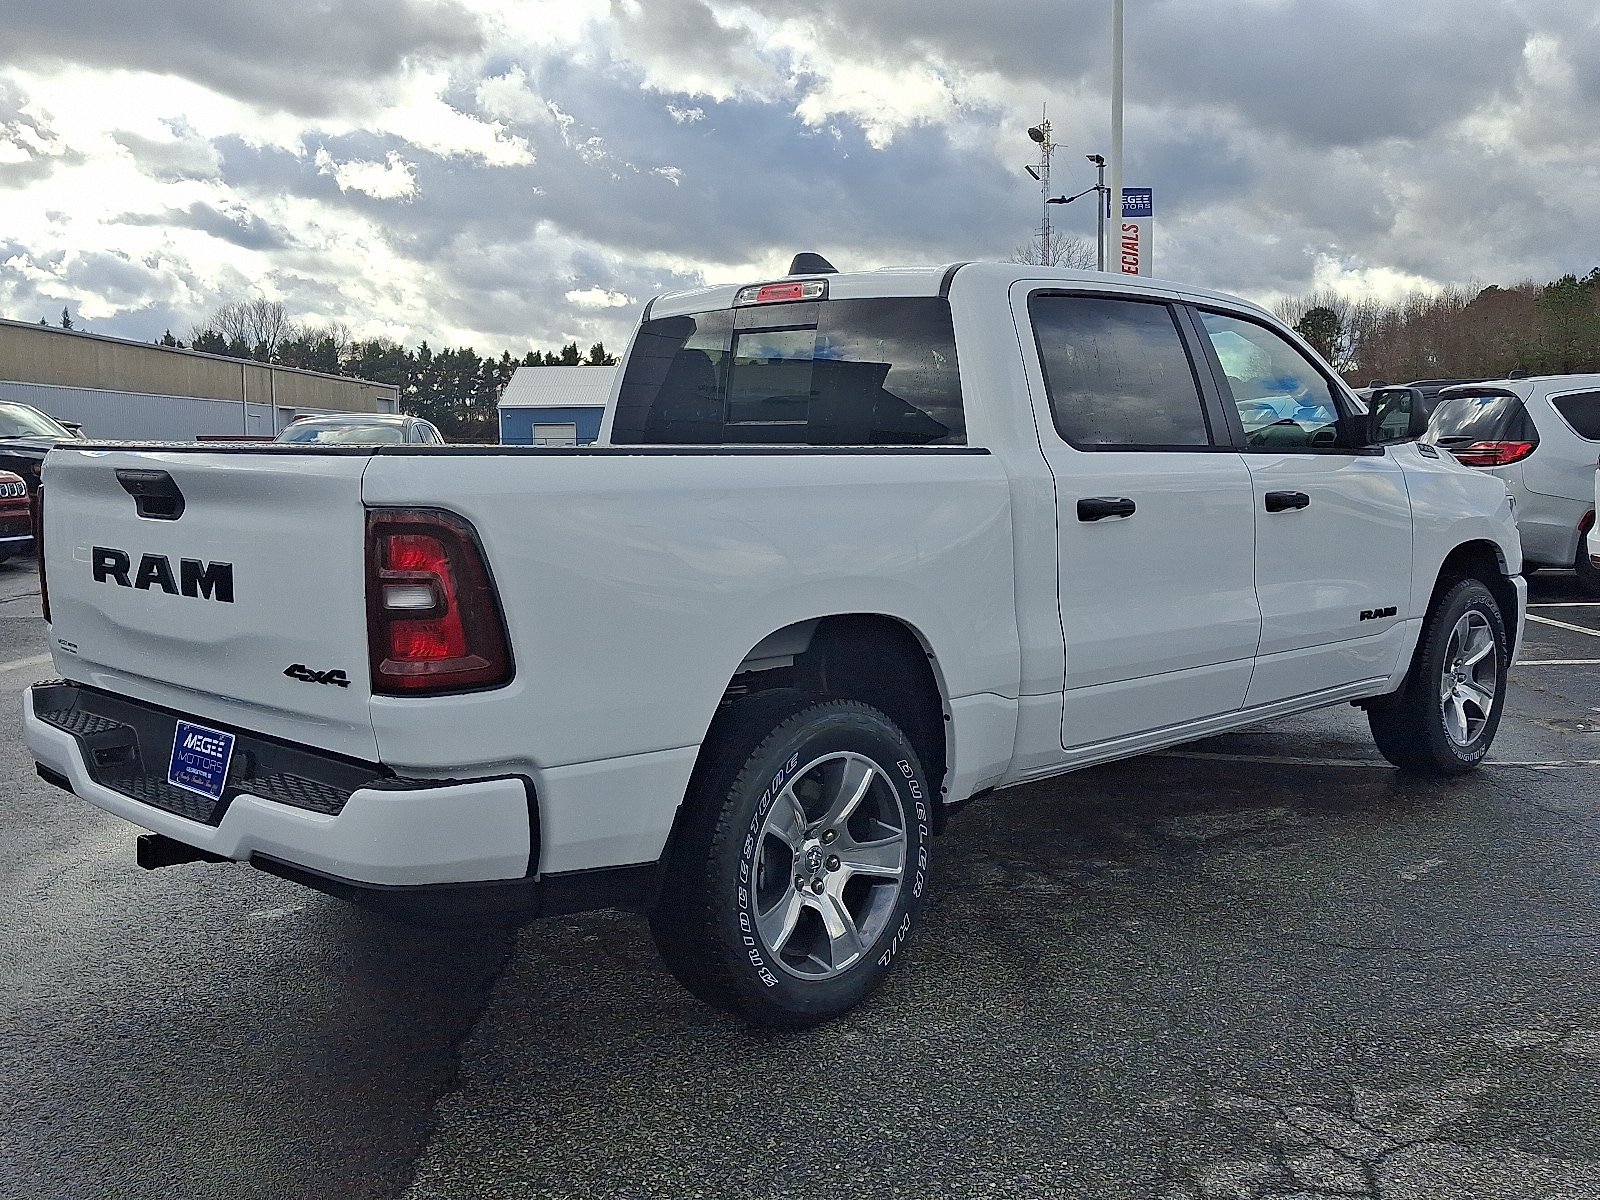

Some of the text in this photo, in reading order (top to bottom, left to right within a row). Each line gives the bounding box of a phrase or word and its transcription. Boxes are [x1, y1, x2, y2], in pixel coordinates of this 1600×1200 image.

[1121, 194, 1150, 204] EGEE
[1121, 223, 1139, 275] ECIALS
[92, 545, 235, 604] RAM
[1359, 605, 1398, 622] RAM
[177, 749, 224, 774] MOTORS
[182, 732, 225, 759] MEGEE
[896, 758, 929, 899] DUELER
[737, 751, 799, 989] BRIDGESTONE
